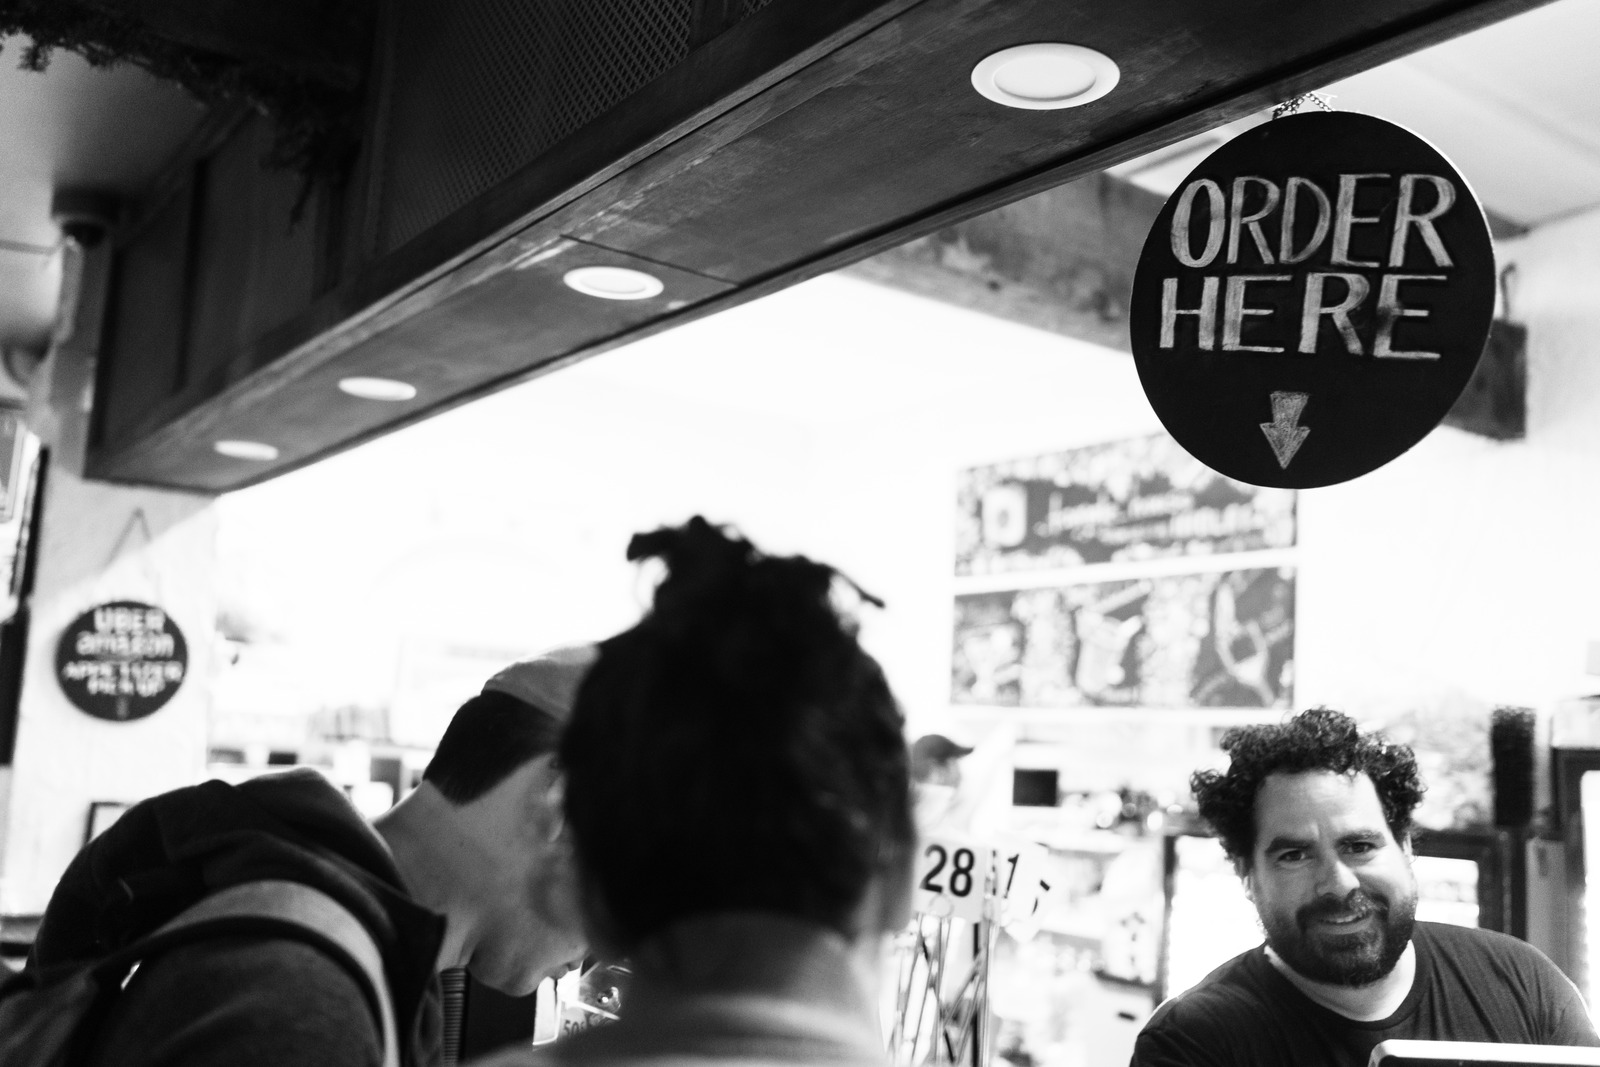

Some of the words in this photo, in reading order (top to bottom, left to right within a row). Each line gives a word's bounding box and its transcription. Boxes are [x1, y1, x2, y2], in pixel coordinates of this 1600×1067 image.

[1170, 172, 1456, 268] ORDER
[1159, 272, 1448, 361] HERE
[94, 607, 165, 632] UBER
[919, 844, 975, 898] 28
